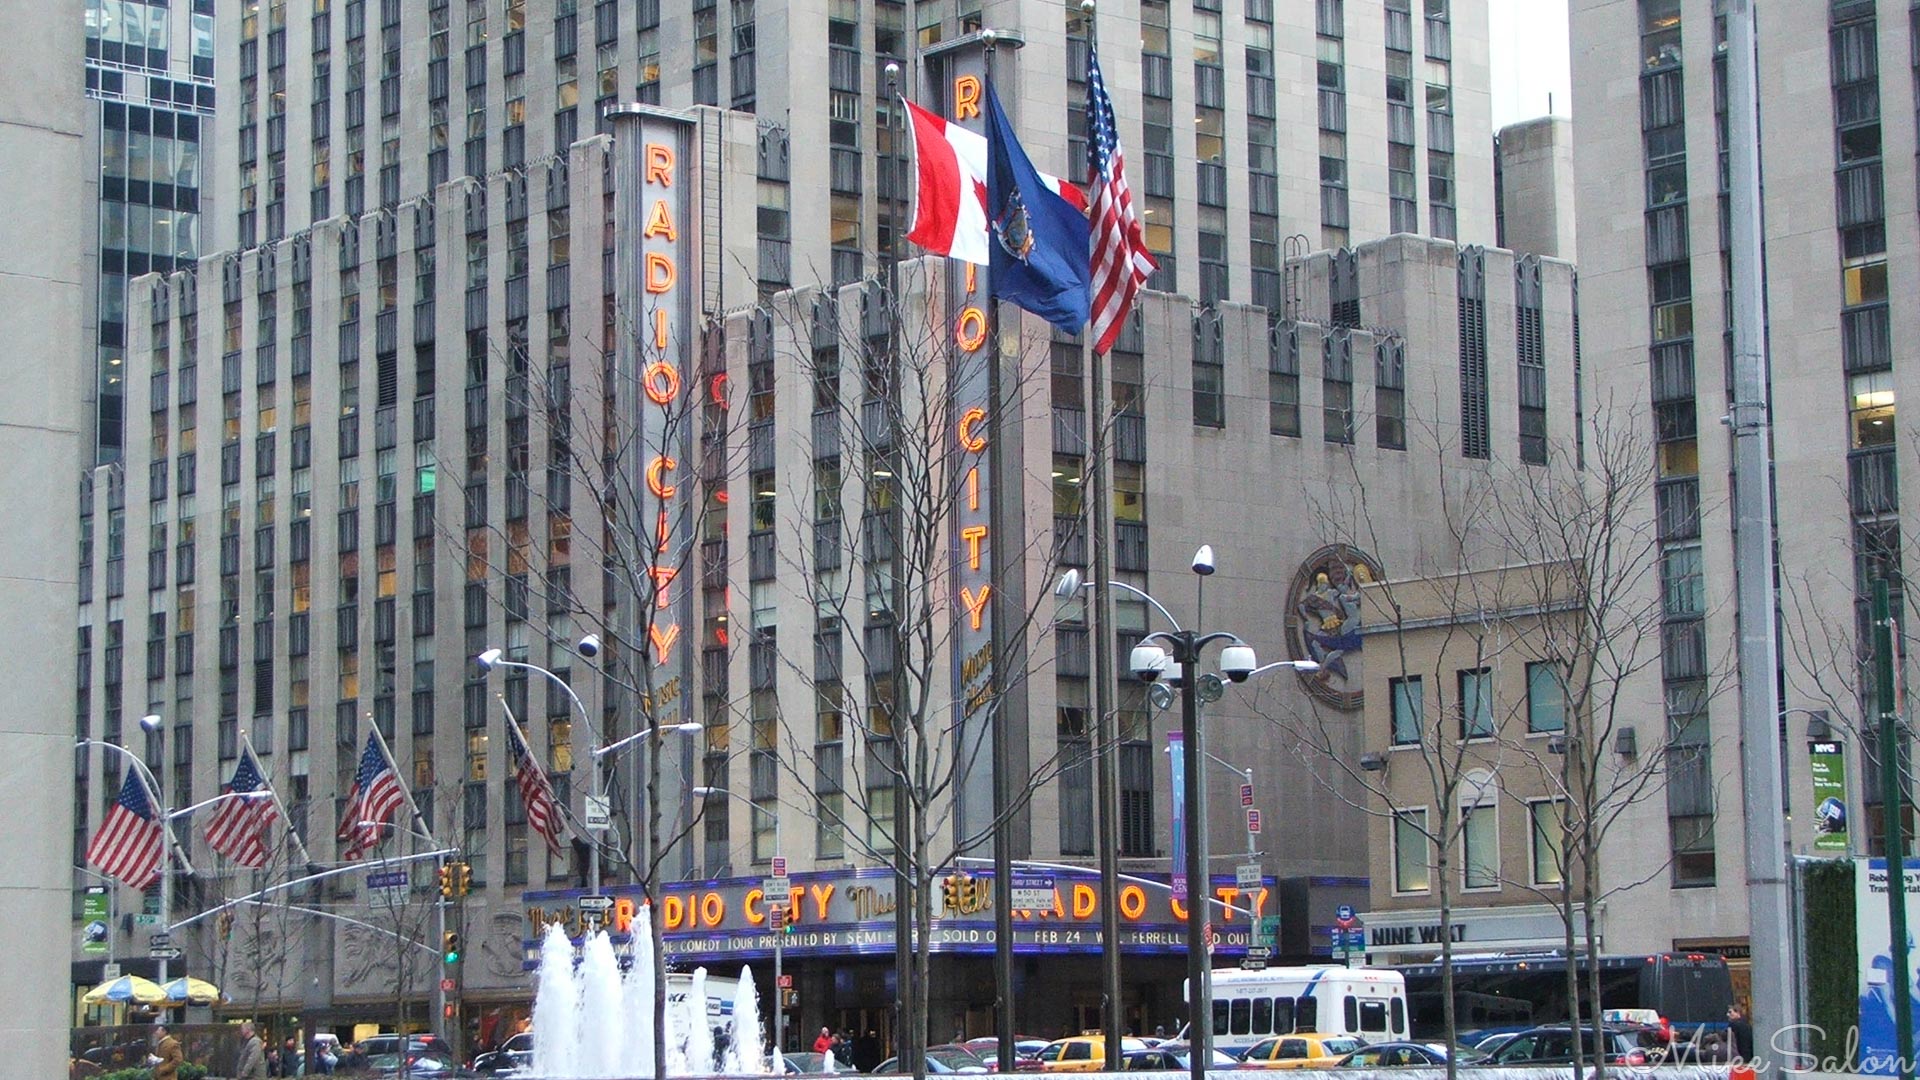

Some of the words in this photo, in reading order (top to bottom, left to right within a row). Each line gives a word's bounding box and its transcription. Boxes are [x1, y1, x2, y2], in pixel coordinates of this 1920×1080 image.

[644, 142, 680, 403] RADIO
[955, 74, 987, 352] RIO
[646, 454, 681, 665] CITY
[959, 406, 990, 630] CITY
[1815, 744, 1836, 752] NYC
[615, 891, 723, 932] RDIO
[744, 883, 835, 923] CTY
[681, 938, 720, 952] COMEDY
[727, 936, 754, 950] TOUR
[823, 933, 837, 945] BY
[847, 931, 880, 944] SEMI
[942, 930, 979, 942] SOLD
[1034, 931, 1058, 943] FEB
[1065, 931, 1080, 943] 24
[1131, 932, 1182, 944] FERRELL
[1227, 932, 1249, 944] OUT
[1372, 927, 1415, 945] NINE
